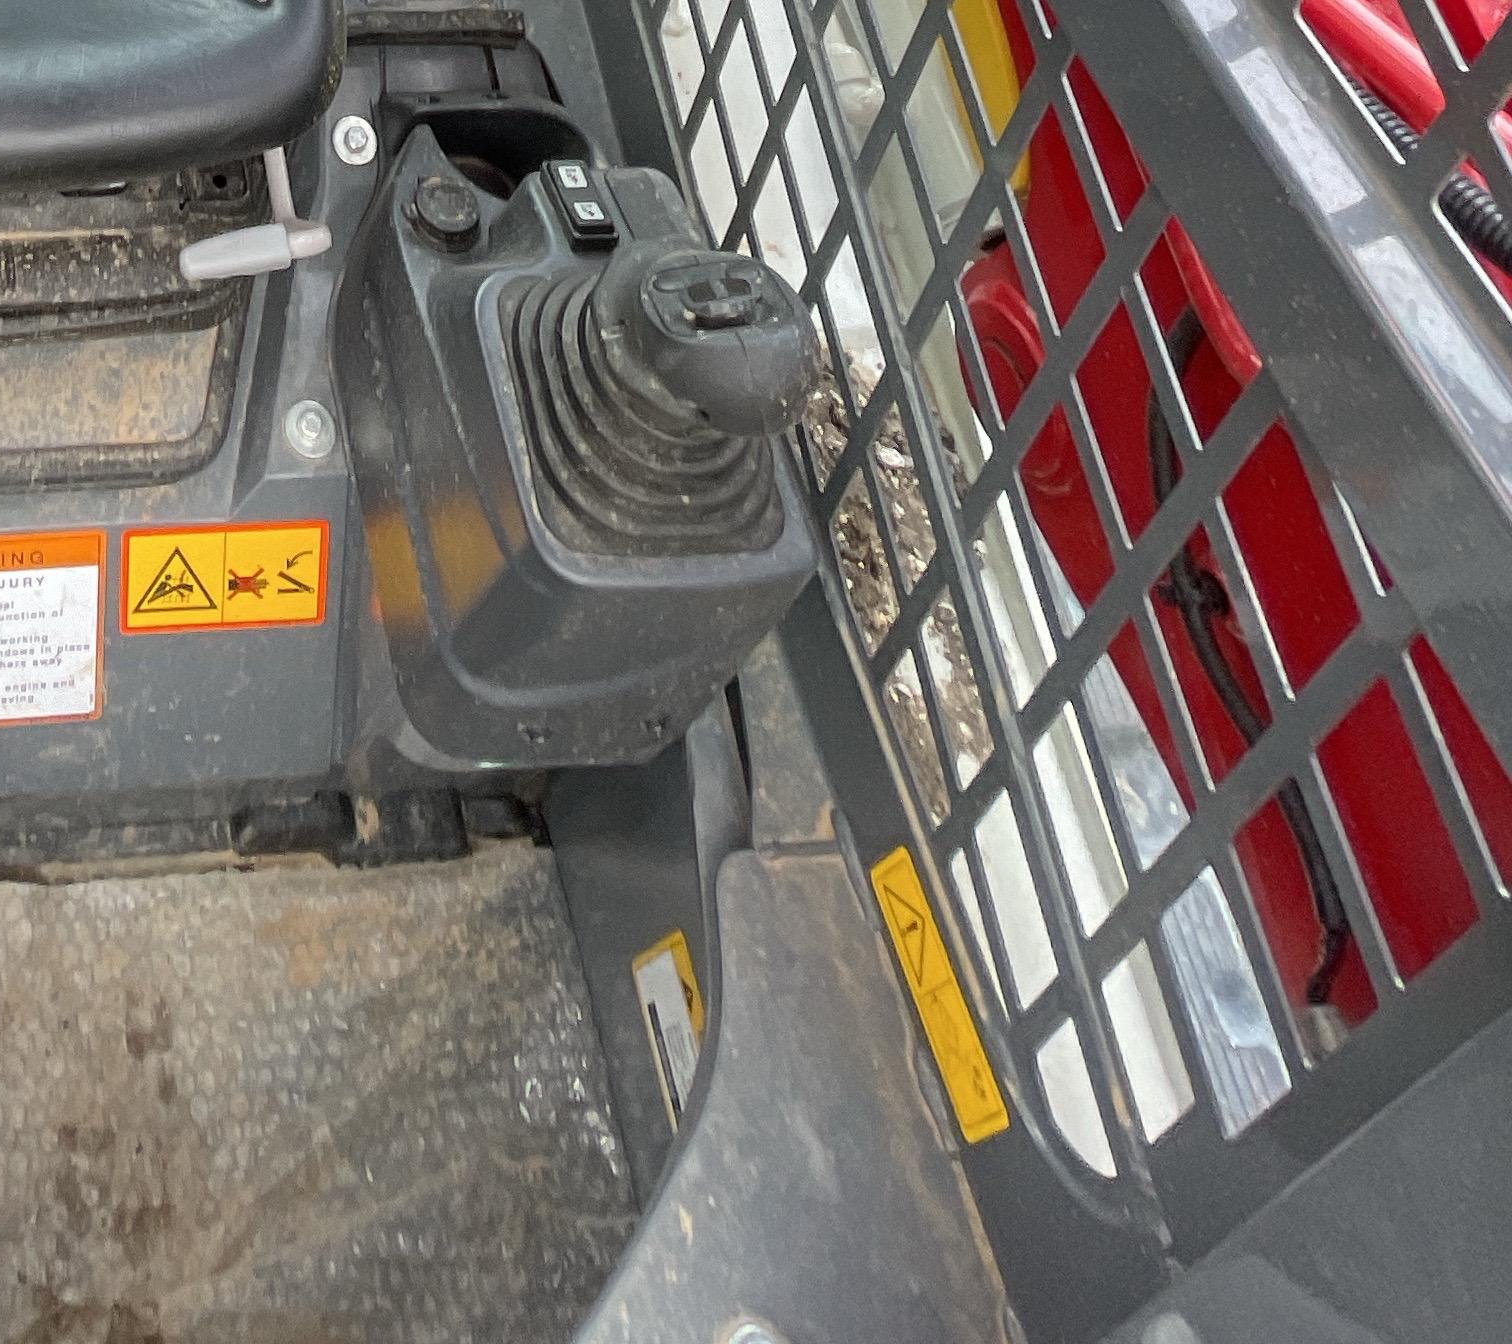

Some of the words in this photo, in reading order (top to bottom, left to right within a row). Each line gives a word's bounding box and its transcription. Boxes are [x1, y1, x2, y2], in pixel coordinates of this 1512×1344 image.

[0, 634, 48, 644] working
[32, 657, 62, 667] away
[5, 682, 47, 692] engine
[53, 679, 75, 689] and
